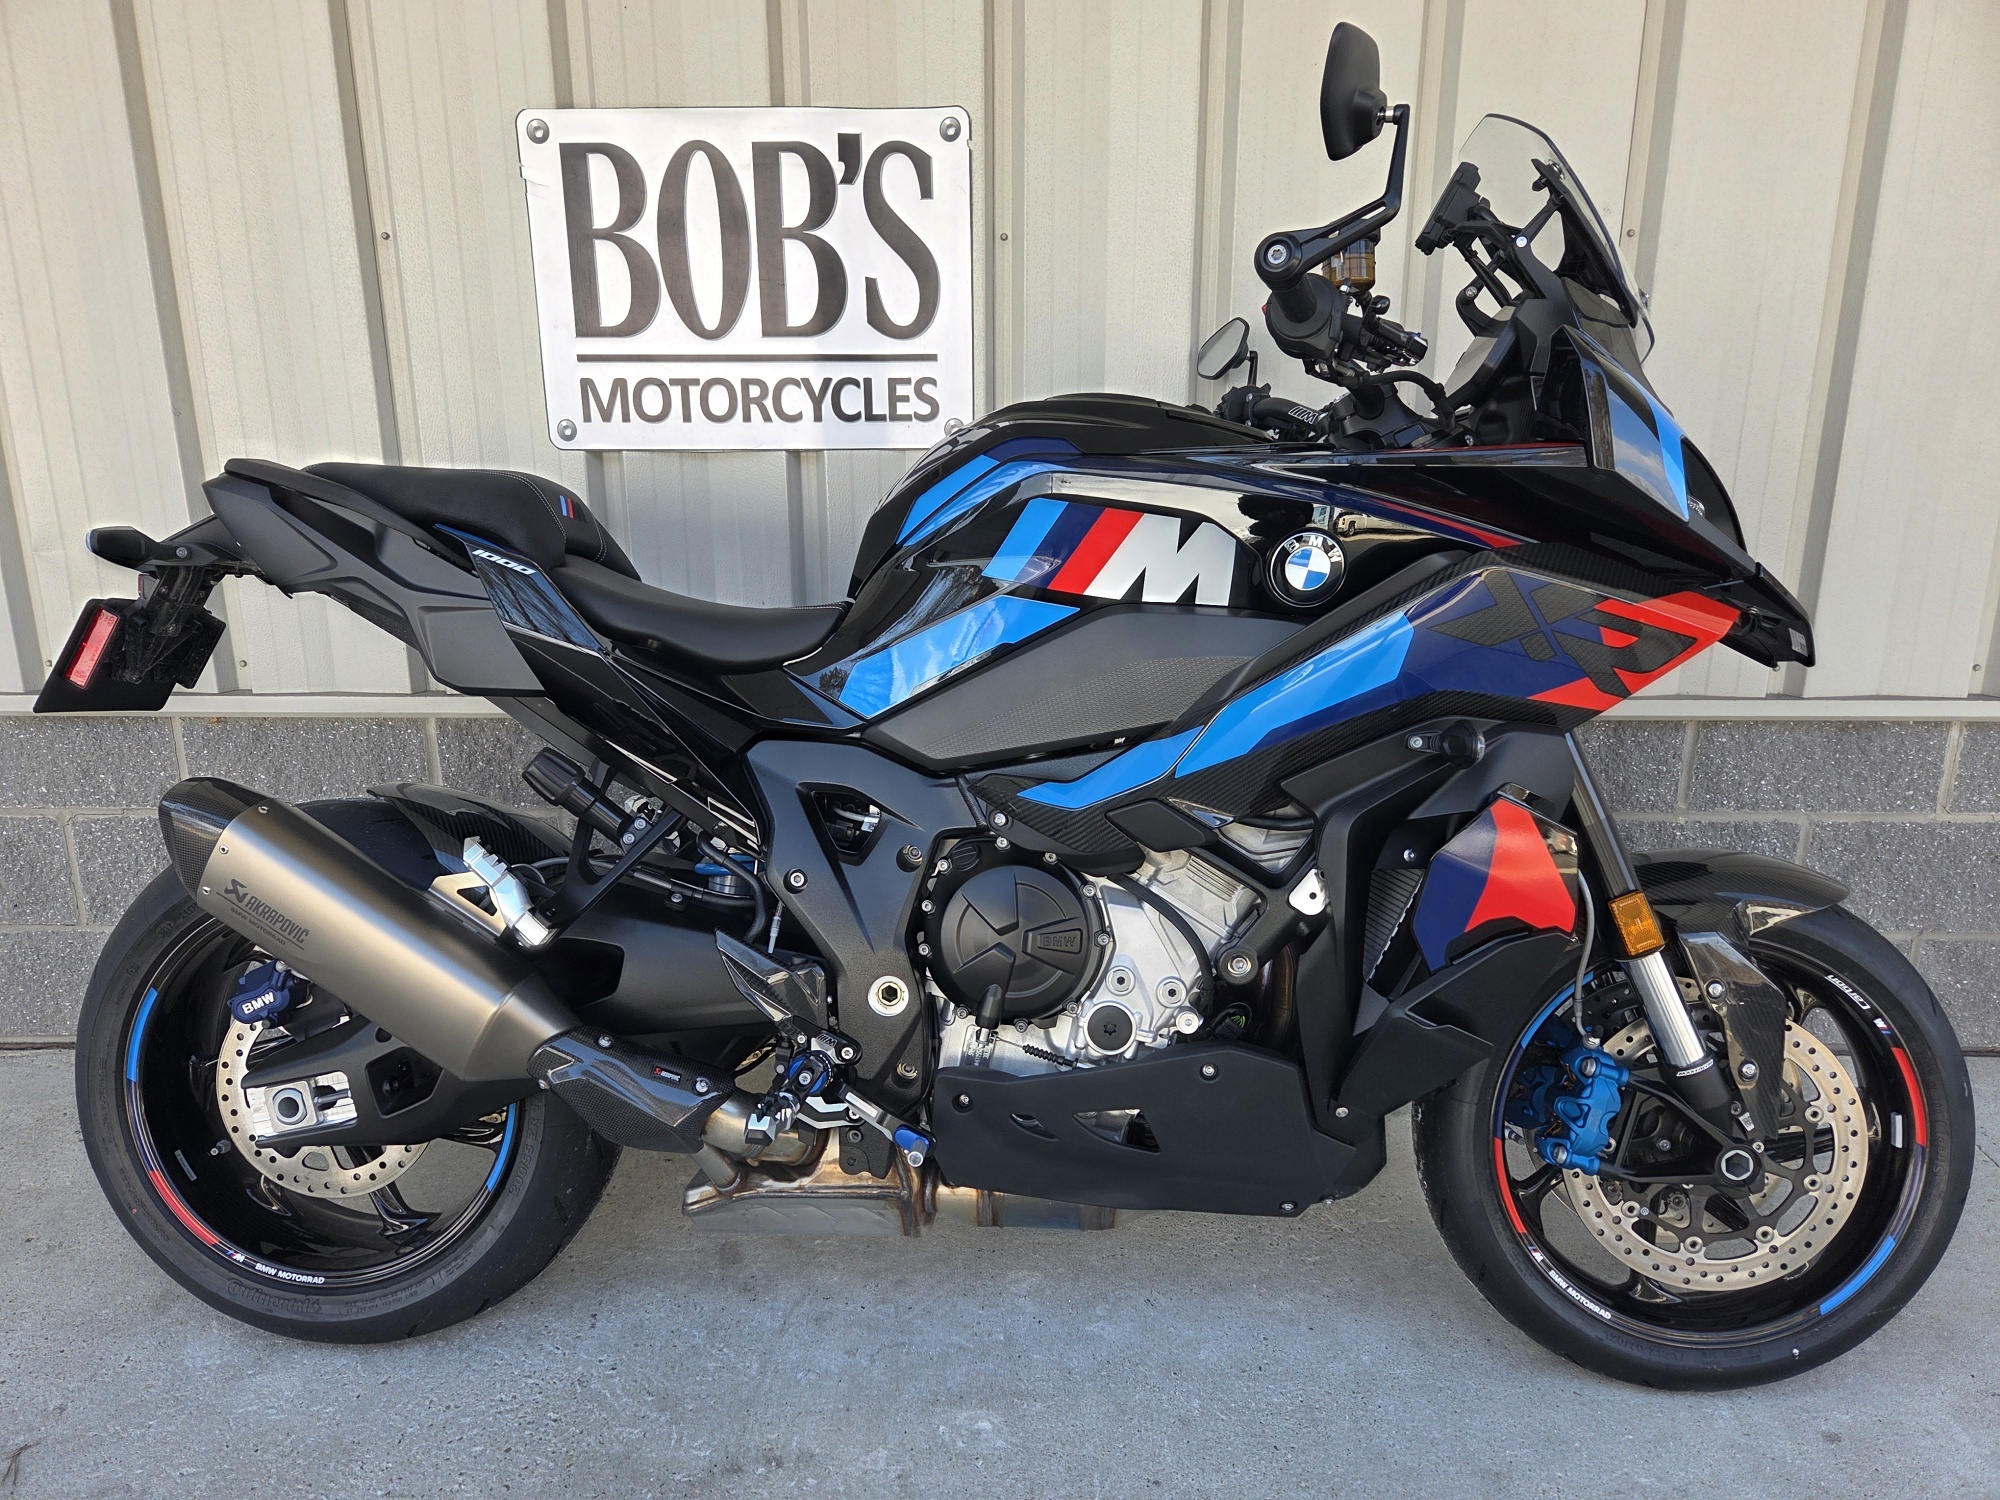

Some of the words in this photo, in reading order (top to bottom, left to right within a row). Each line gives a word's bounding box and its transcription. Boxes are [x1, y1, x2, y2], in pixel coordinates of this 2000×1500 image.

[559, 132, 941, 340] BOB'S
[579, 377, 940, 424] MOTORCYCLES
[472, 549, 537, 575] 1000
[1083, 513, 1237, 606] M
[1284, 535, 1342, 563] BMW
[230, 907, 248, 921] BMW
[248, 918, 286, 946] MOTORRAD
[1042, 935, 1077, 948] BMW
[241, 991, 275, 1014] BMW
[255, 1262, 277, 1276] BMW
[277, 1270, 326, 1285] MOTORRAD
[1548, 1269, 1569, 1289] BMW
[1566, 1286, 1612, 1319] MOTORRAD
